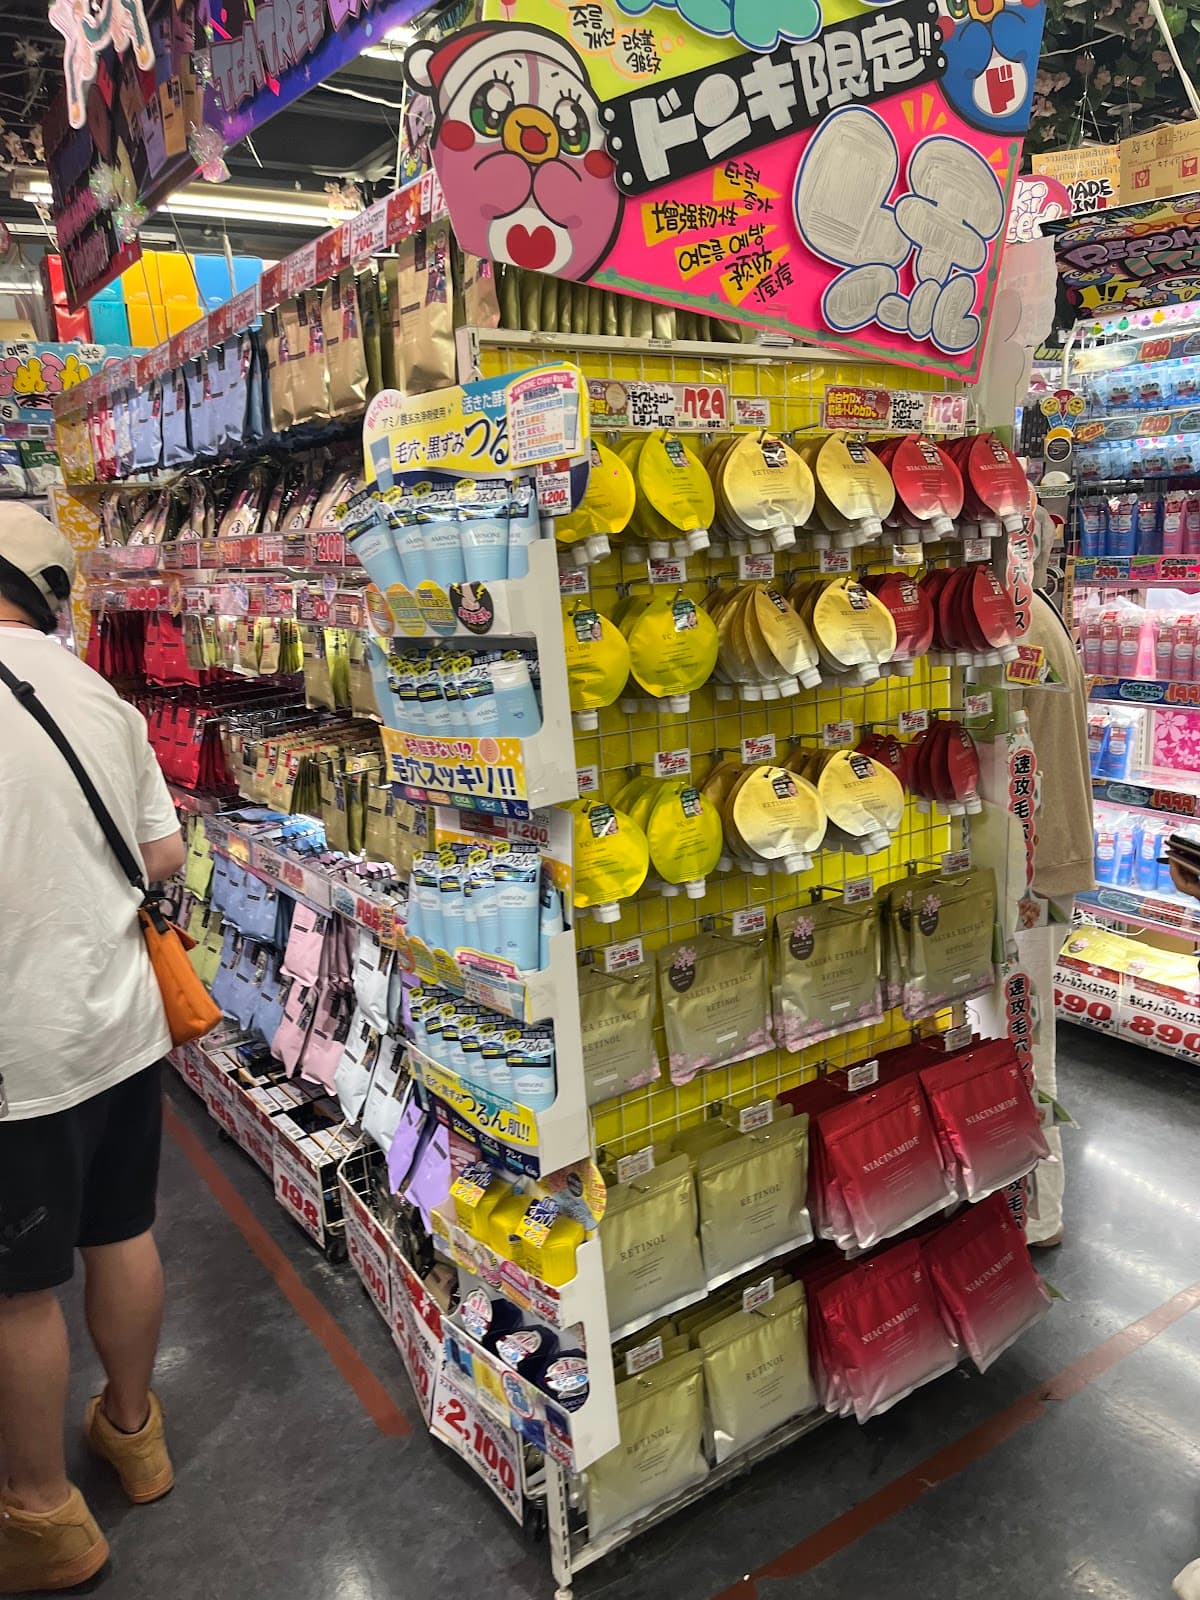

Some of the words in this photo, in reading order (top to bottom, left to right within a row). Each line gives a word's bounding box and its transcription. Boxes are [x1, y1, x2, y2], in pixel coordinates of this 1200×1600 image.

[568, 4, 603, 29] 주름
[584, 28, 616, 49] 개선
[621, 29, 655, 53] 改善
[724, 161, 760, 190] 탄력
[743, 189, 774, 213] 증가
[679, 239, 727, 272] 여드름
[729, 222, 766, 254] 예방
[390, 752, 517, 796] 毛穴スッキリ!!
[965, 1096, 1019, 1126] NIACINAMIDE
[862, 1135, 920, 1174] NIACINAMIDE
[279, 1173, 319, 1228] 198
[739, 1183, 782, 1207] RETINOL
[620, 1233, 667, 1262] RETINOL
[964, 1251, 1015, 1294] NIACINAMIDE
[860, 1303, 920, 1345] NIACINAMIDE
[745, 1354, 785, 1382] RETINOL
[625, 1424, 672, 1456] RETINOL
